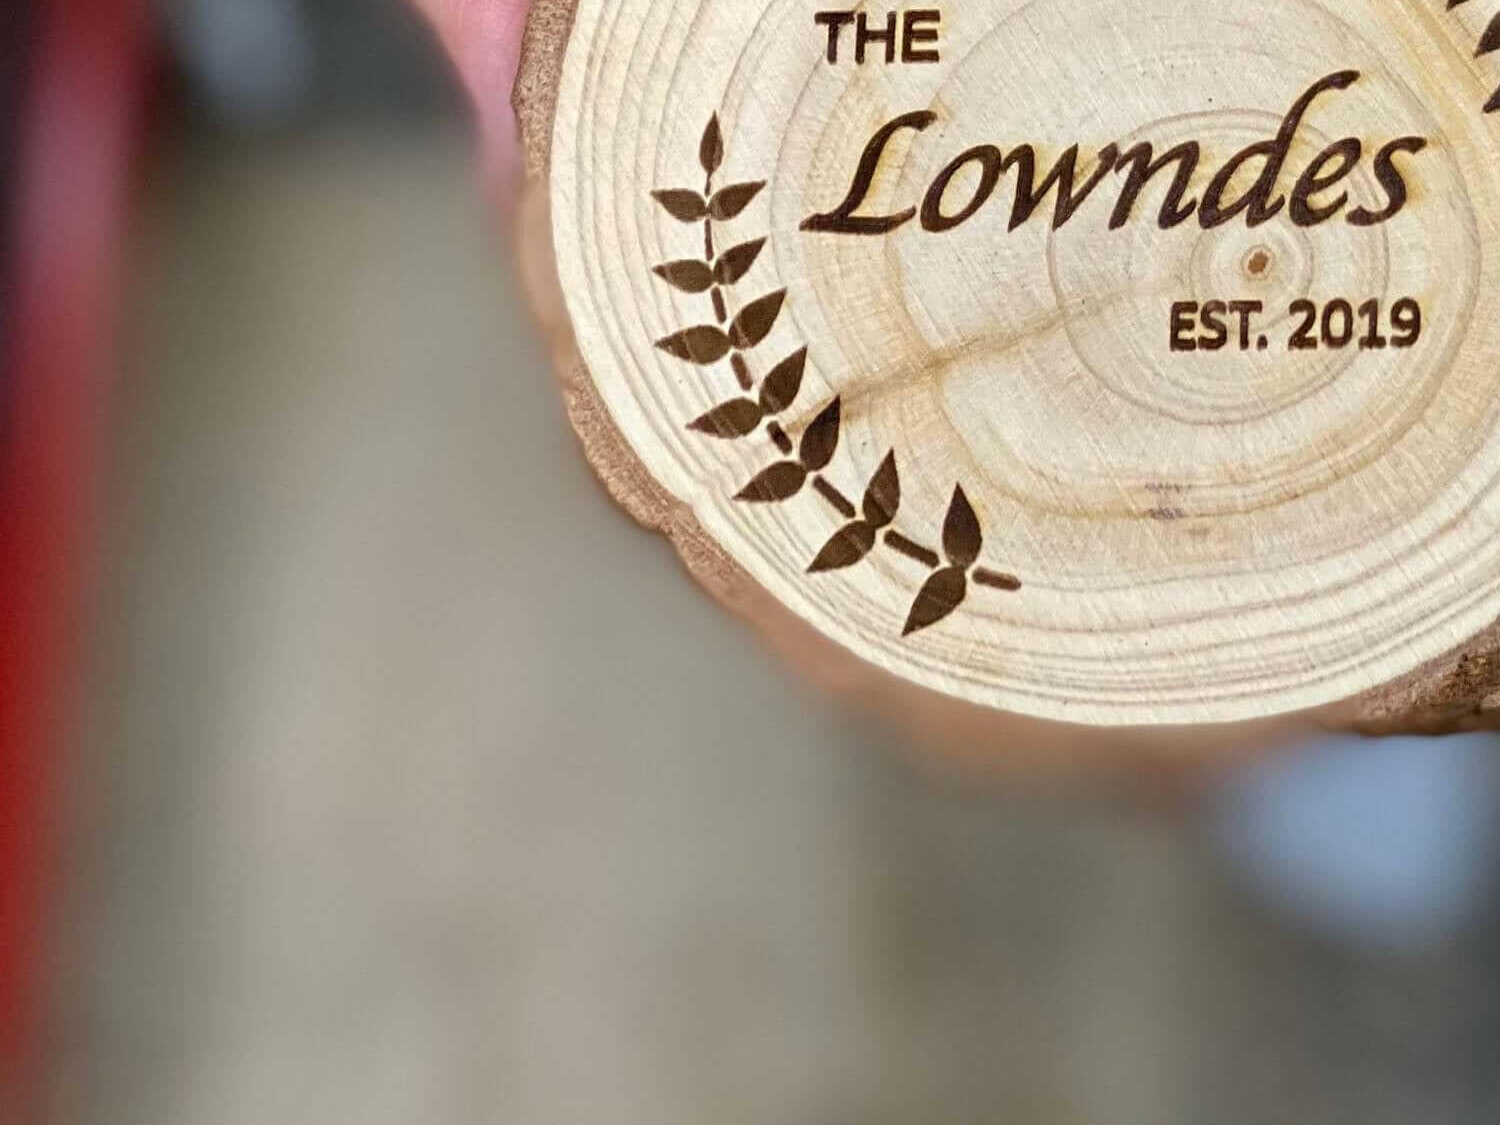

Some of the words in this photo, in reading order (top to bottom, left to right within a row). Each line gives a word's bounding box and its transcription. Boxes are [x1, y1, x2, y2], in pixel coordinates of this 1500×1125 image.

[814, 9, 941, 64] THE
[799, 69, 1428, 236] Lowndes
[1169, 299, 1269, 352] EST.
[1287, 297, 1422, 351] 2019
